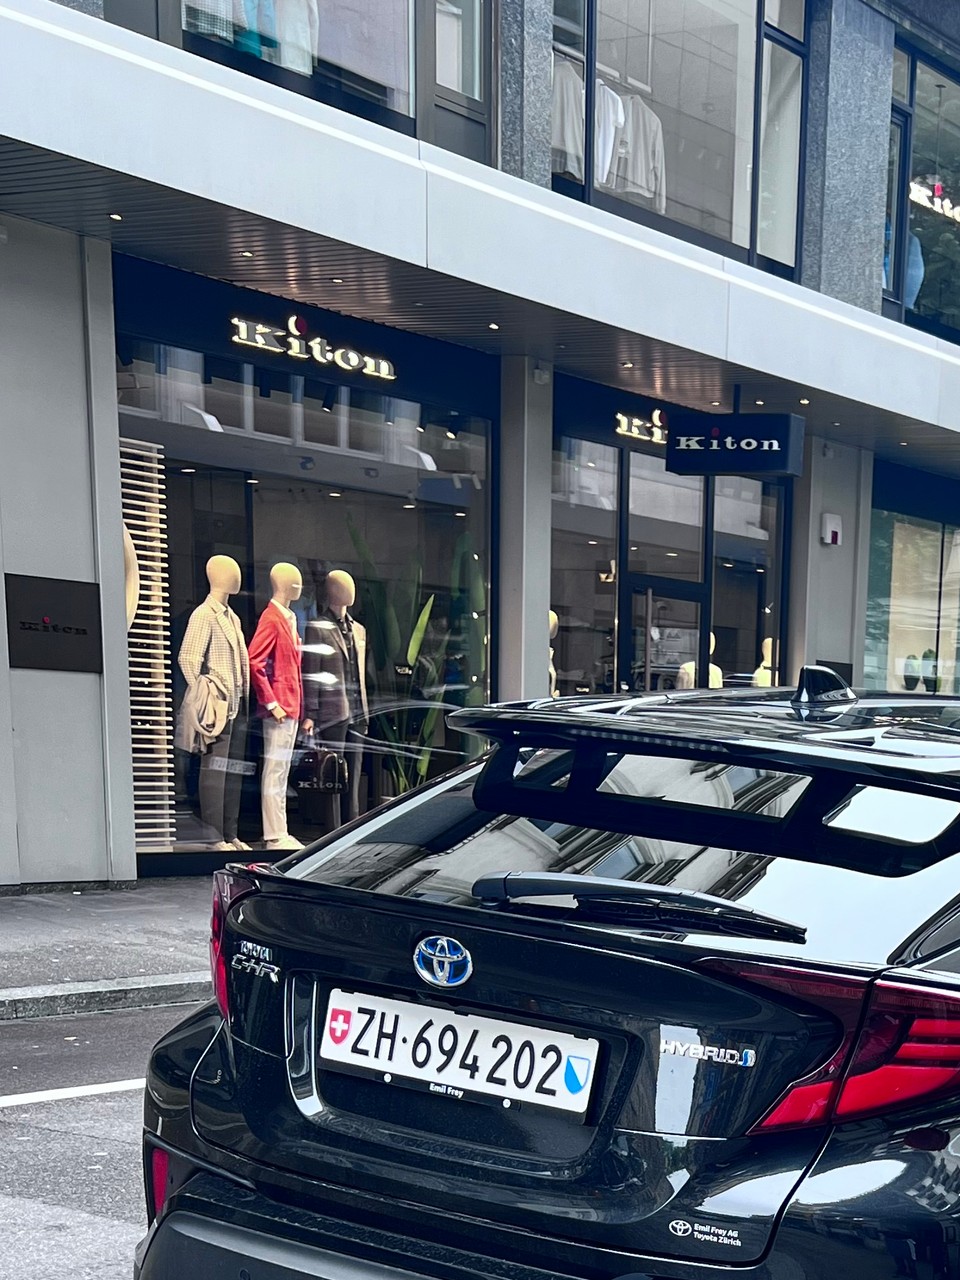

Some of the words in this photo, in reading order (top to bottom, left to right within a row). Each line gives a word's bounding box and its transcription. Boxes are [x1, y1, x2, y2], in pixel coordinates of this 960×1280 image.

[231, 315, 397, 380] Kiton
[675, 427, 781, 451] Kiton
[19, 616, 88, 636] Kiton
[298, 777, 342, 789] Kiton
[231, 954, 280, 983] C-HR
[660, 1040, 740, 1064] HYBRID
[429, 1083, 446, 1094] Emil
[447, 1086, 464, 1099] Frey
[693, 1232, 717, 1241] Toyota
[718, 1236, 742, 1246] Zürich
[694, 1224, 710, 1232] Emil
[711, 1227, 727, 1236] Frey
[727, 1229, 738, 1237] AG
